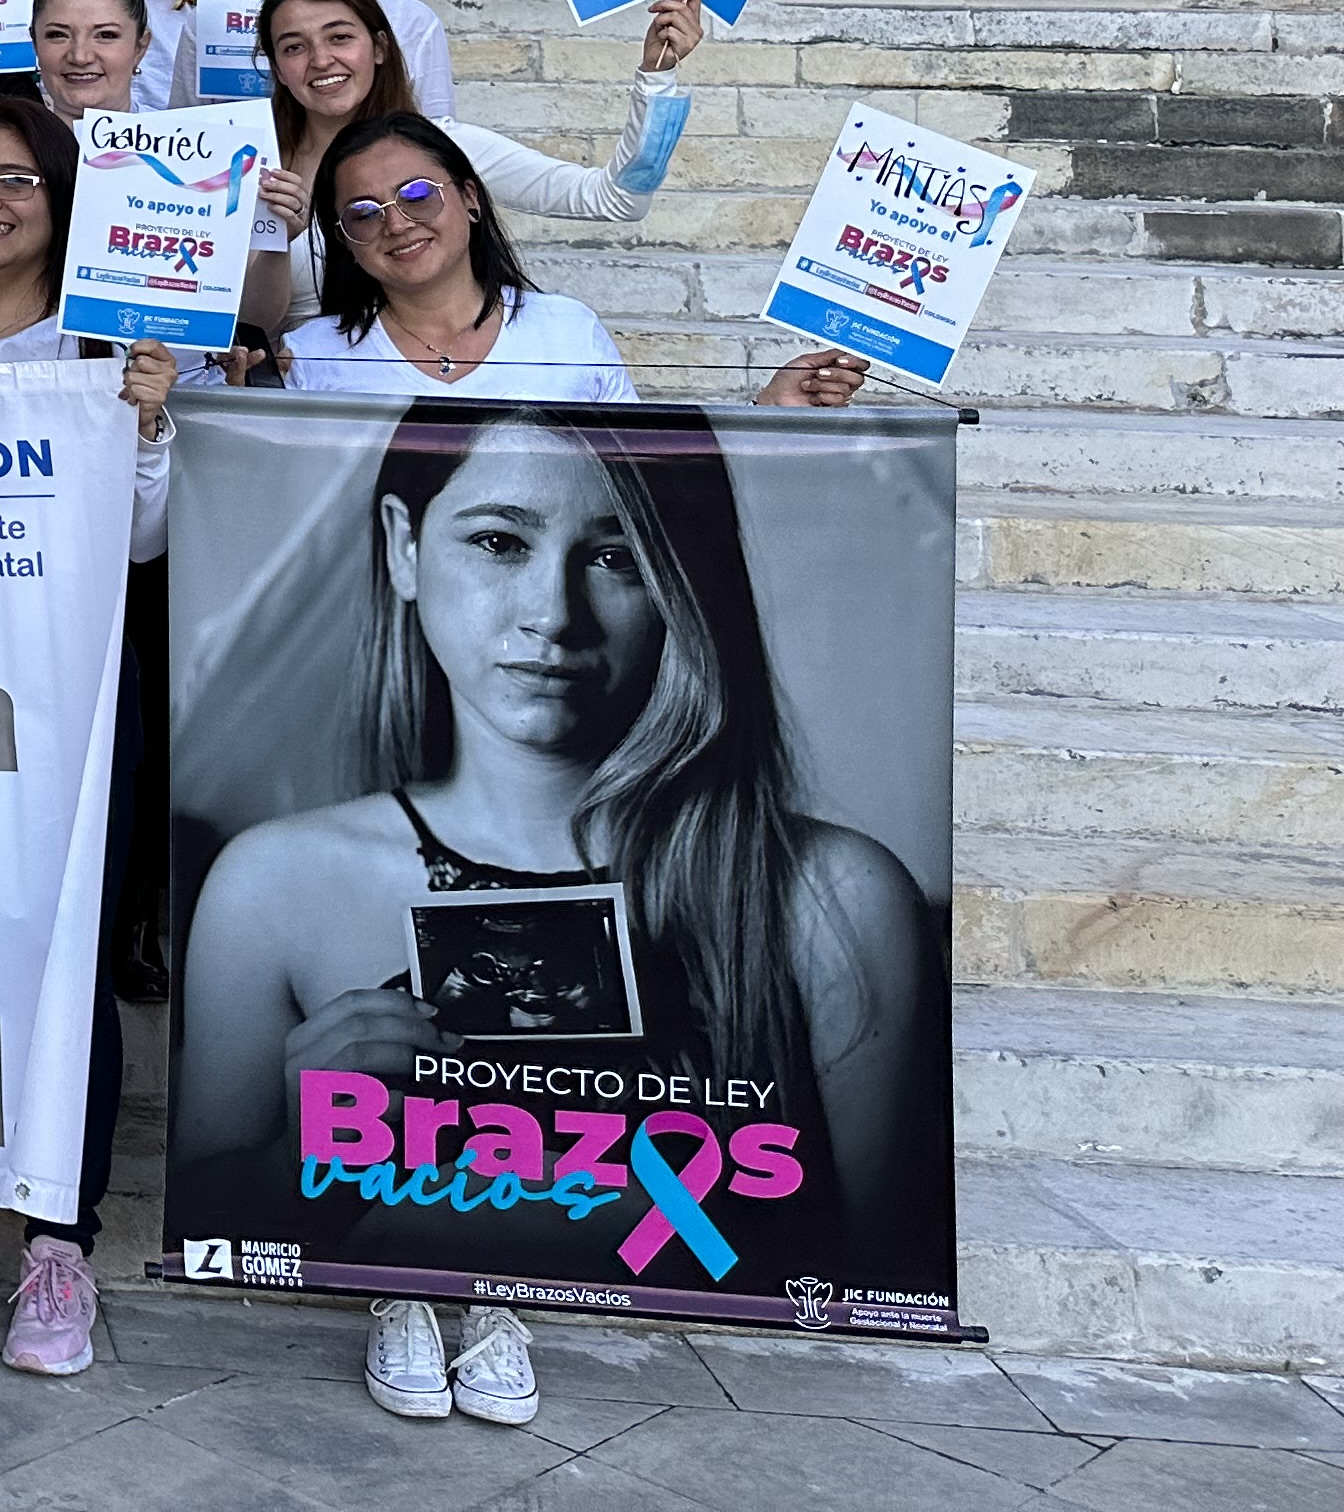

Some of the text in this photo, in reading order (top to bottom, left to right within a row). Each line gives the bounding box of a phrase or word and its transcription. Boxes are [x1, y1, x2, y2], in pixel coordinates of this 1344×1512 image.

[91, 116, 213, 161] Gabriel
[127, 195, 211, 217] Yo apoyo el
[869, 199, 958, 243] Yo apoyo el
[108, 224, 214, 258] Brazos
[135, 223, 211, 238] PROYECTO DE LEY
[871, 228, 948, 265] PROYECTO DE LEY
[839, 224, 950, 284] Brazos
[414, 1055, 775, 1110] PROYECTO DE LEY
[299, 1068, 804, 1200] Brazos
[195, 1243, 223, 1274] L
[241, 1240, 301, 1257] MAURICIO
[244, 1274, 304, 1287] SENADOR
[842, 1289, 949, 1307] JIC FUNDACIÓN
